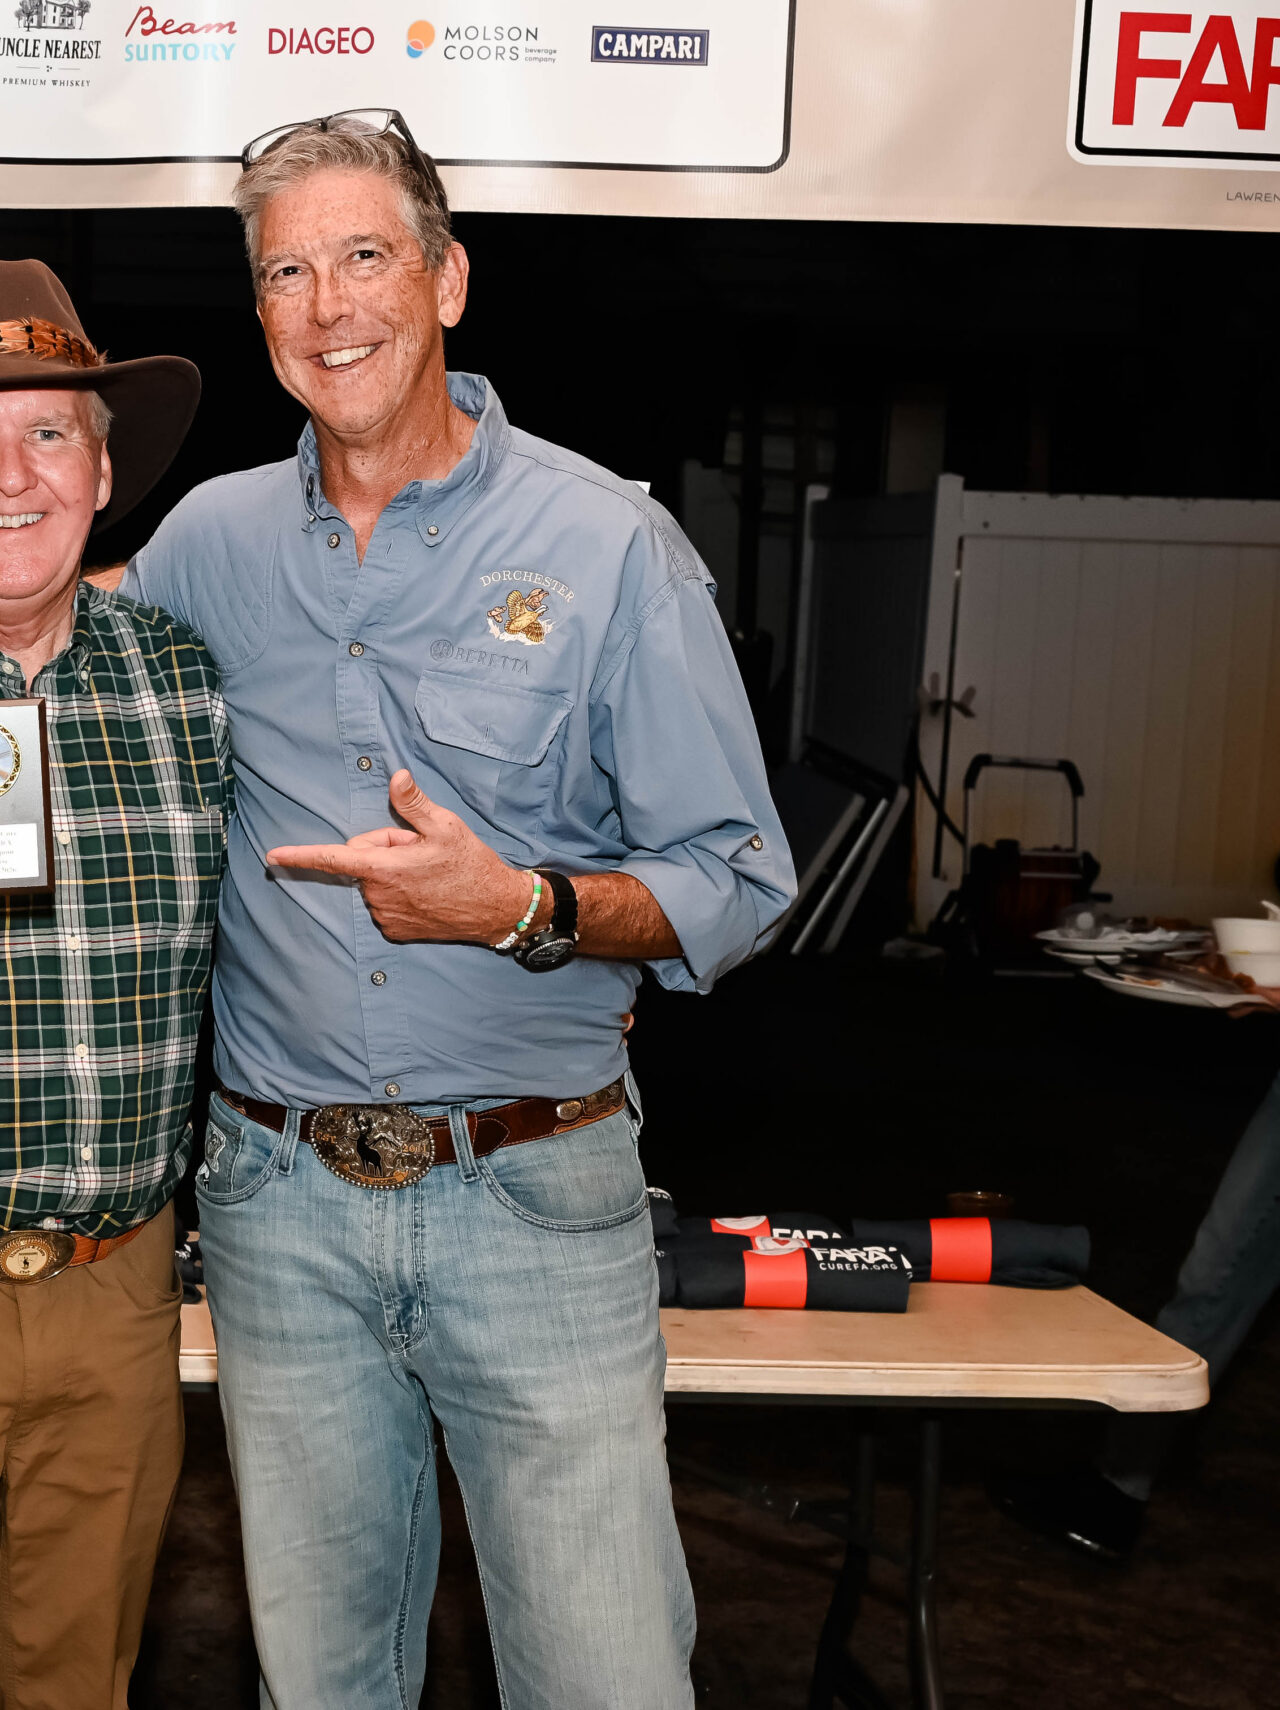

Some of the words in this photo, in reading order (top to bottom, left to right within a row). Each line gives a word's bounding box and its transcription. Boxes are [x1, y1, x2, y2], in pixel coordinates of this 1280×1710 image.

[125, 6, 237, 37] Beam
[268, 27, 375, 55] DIAGEO
[445, 26, 539, 42] MOLSON
[124, 42, 236, 63] SUNTORY
[444, 45, 520, 61] COORS
[525, 46, 557, 56] beverage
[598, 33, 701, 60] CAMPARI
[524, 55, 556, 64] company
[2, 77, 46, 87] PREMIUM
[51, 79, 91, 87] WHISKEY
[479, 570, 575, 603] DORCHESTER
[455, 647, 529, 675] BERETTA
[819, 1262, 898, 1271] CUREFA.ORG
